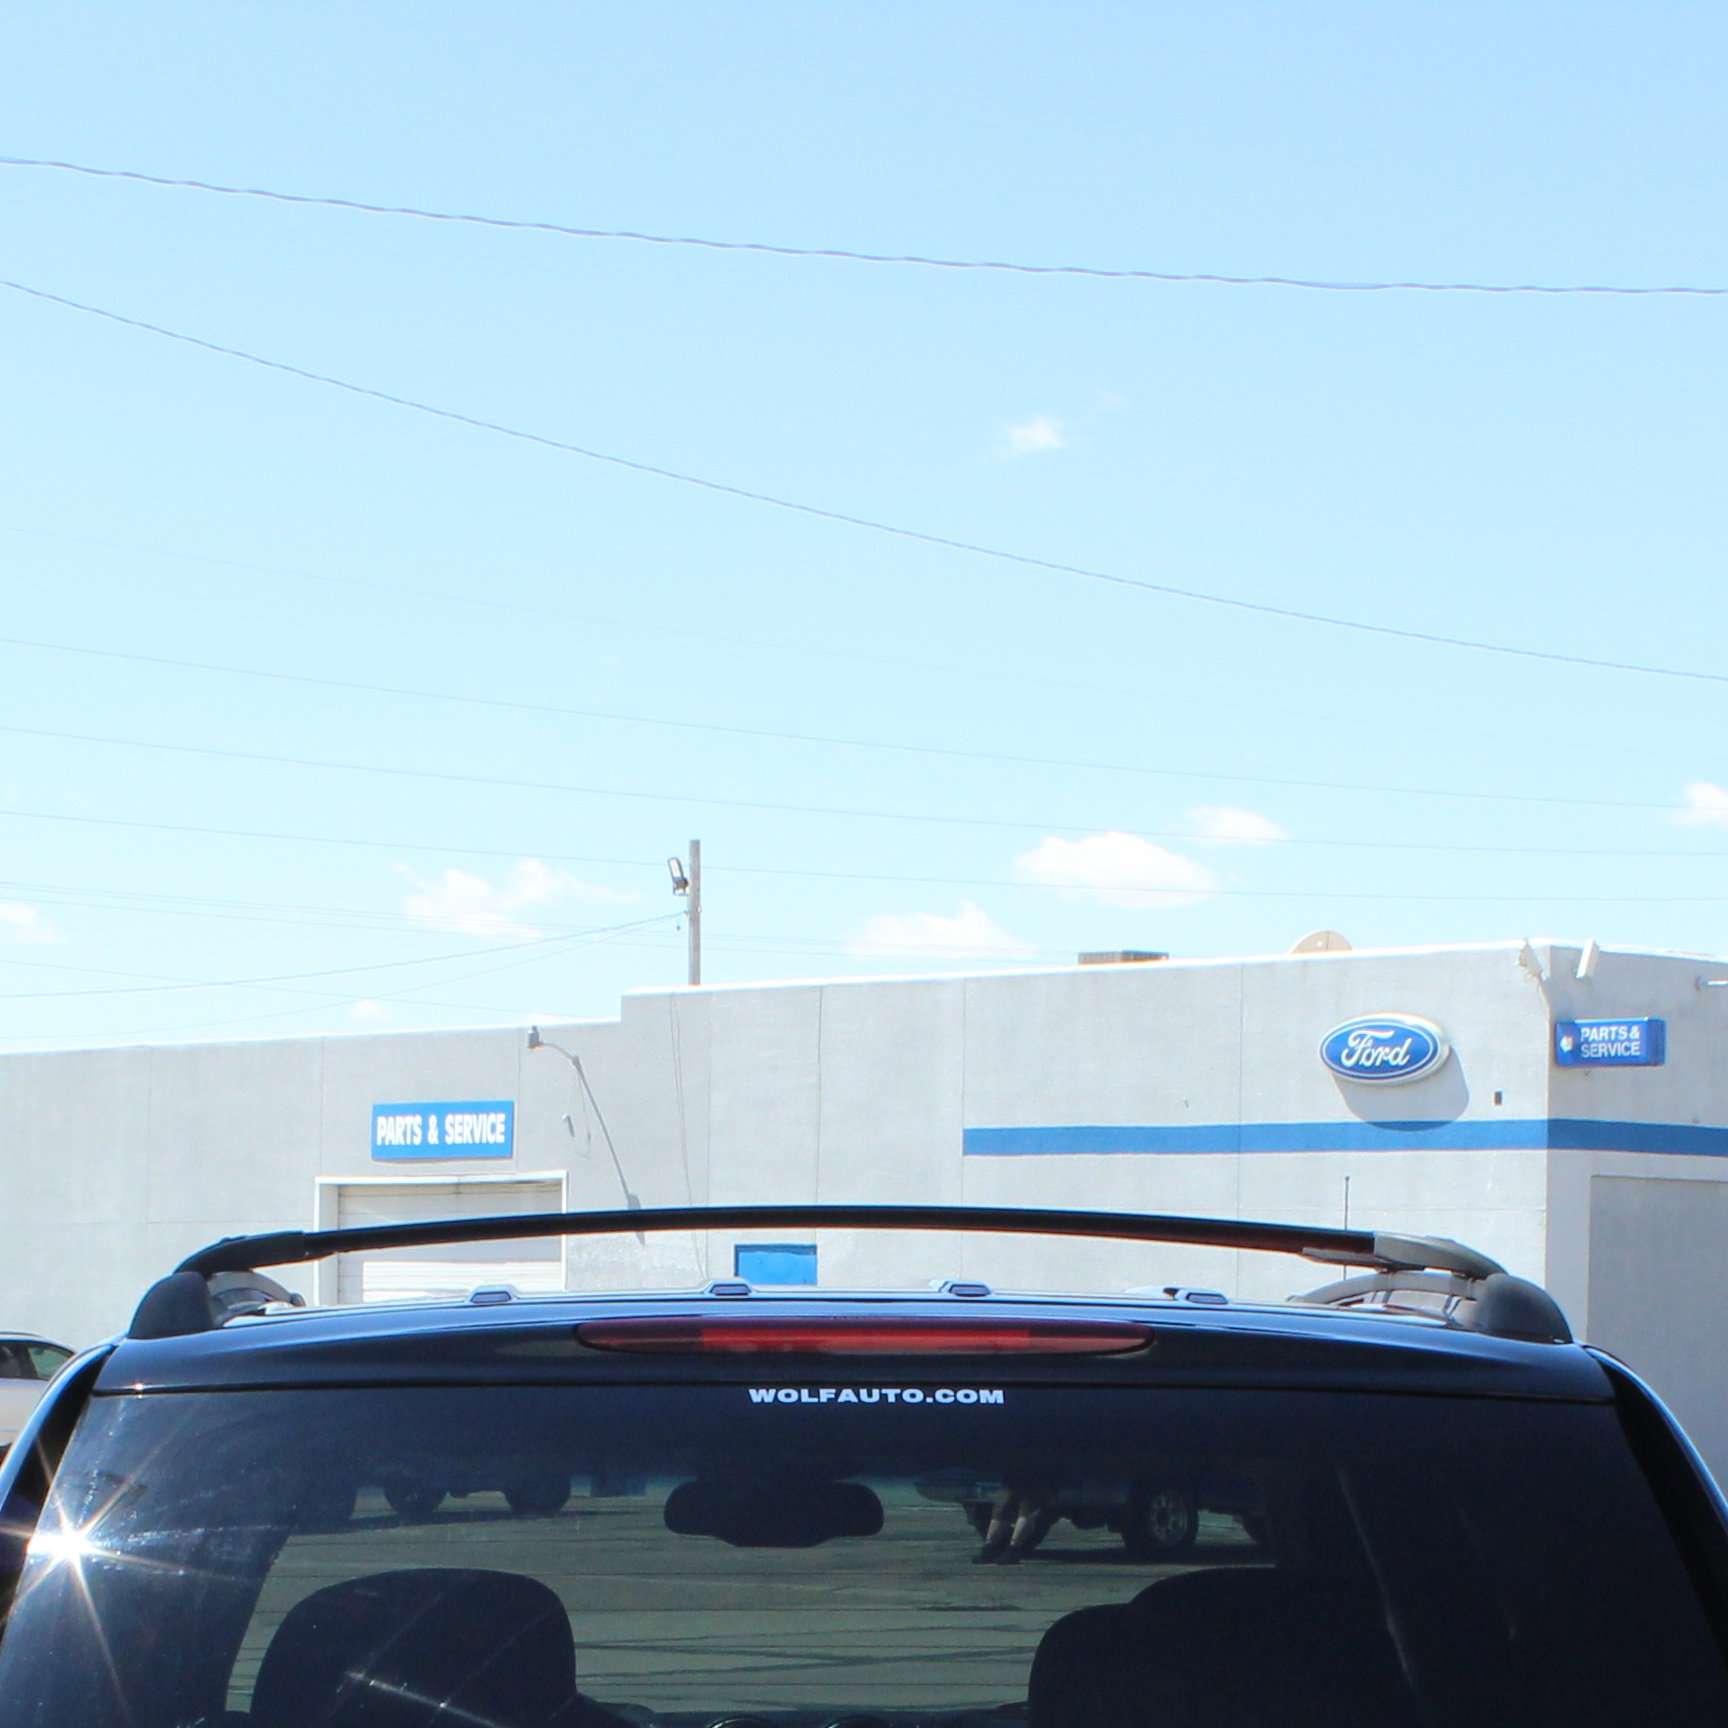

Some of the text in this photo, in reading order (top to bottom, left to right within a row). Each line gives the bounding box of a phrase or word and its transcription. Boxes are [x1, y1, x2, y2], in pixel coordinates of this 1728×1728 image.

[1580, 1026, 1628, 1042] PARTS
[1341, 1029, 1412, 1067] Ford
[1580, 1041, 1641, 1058] SERVICE
[376, 1113, 506, 1146] PARTS & SERVICE
[749, 1388, 1004, 1404] WOLFAUTO.COM
